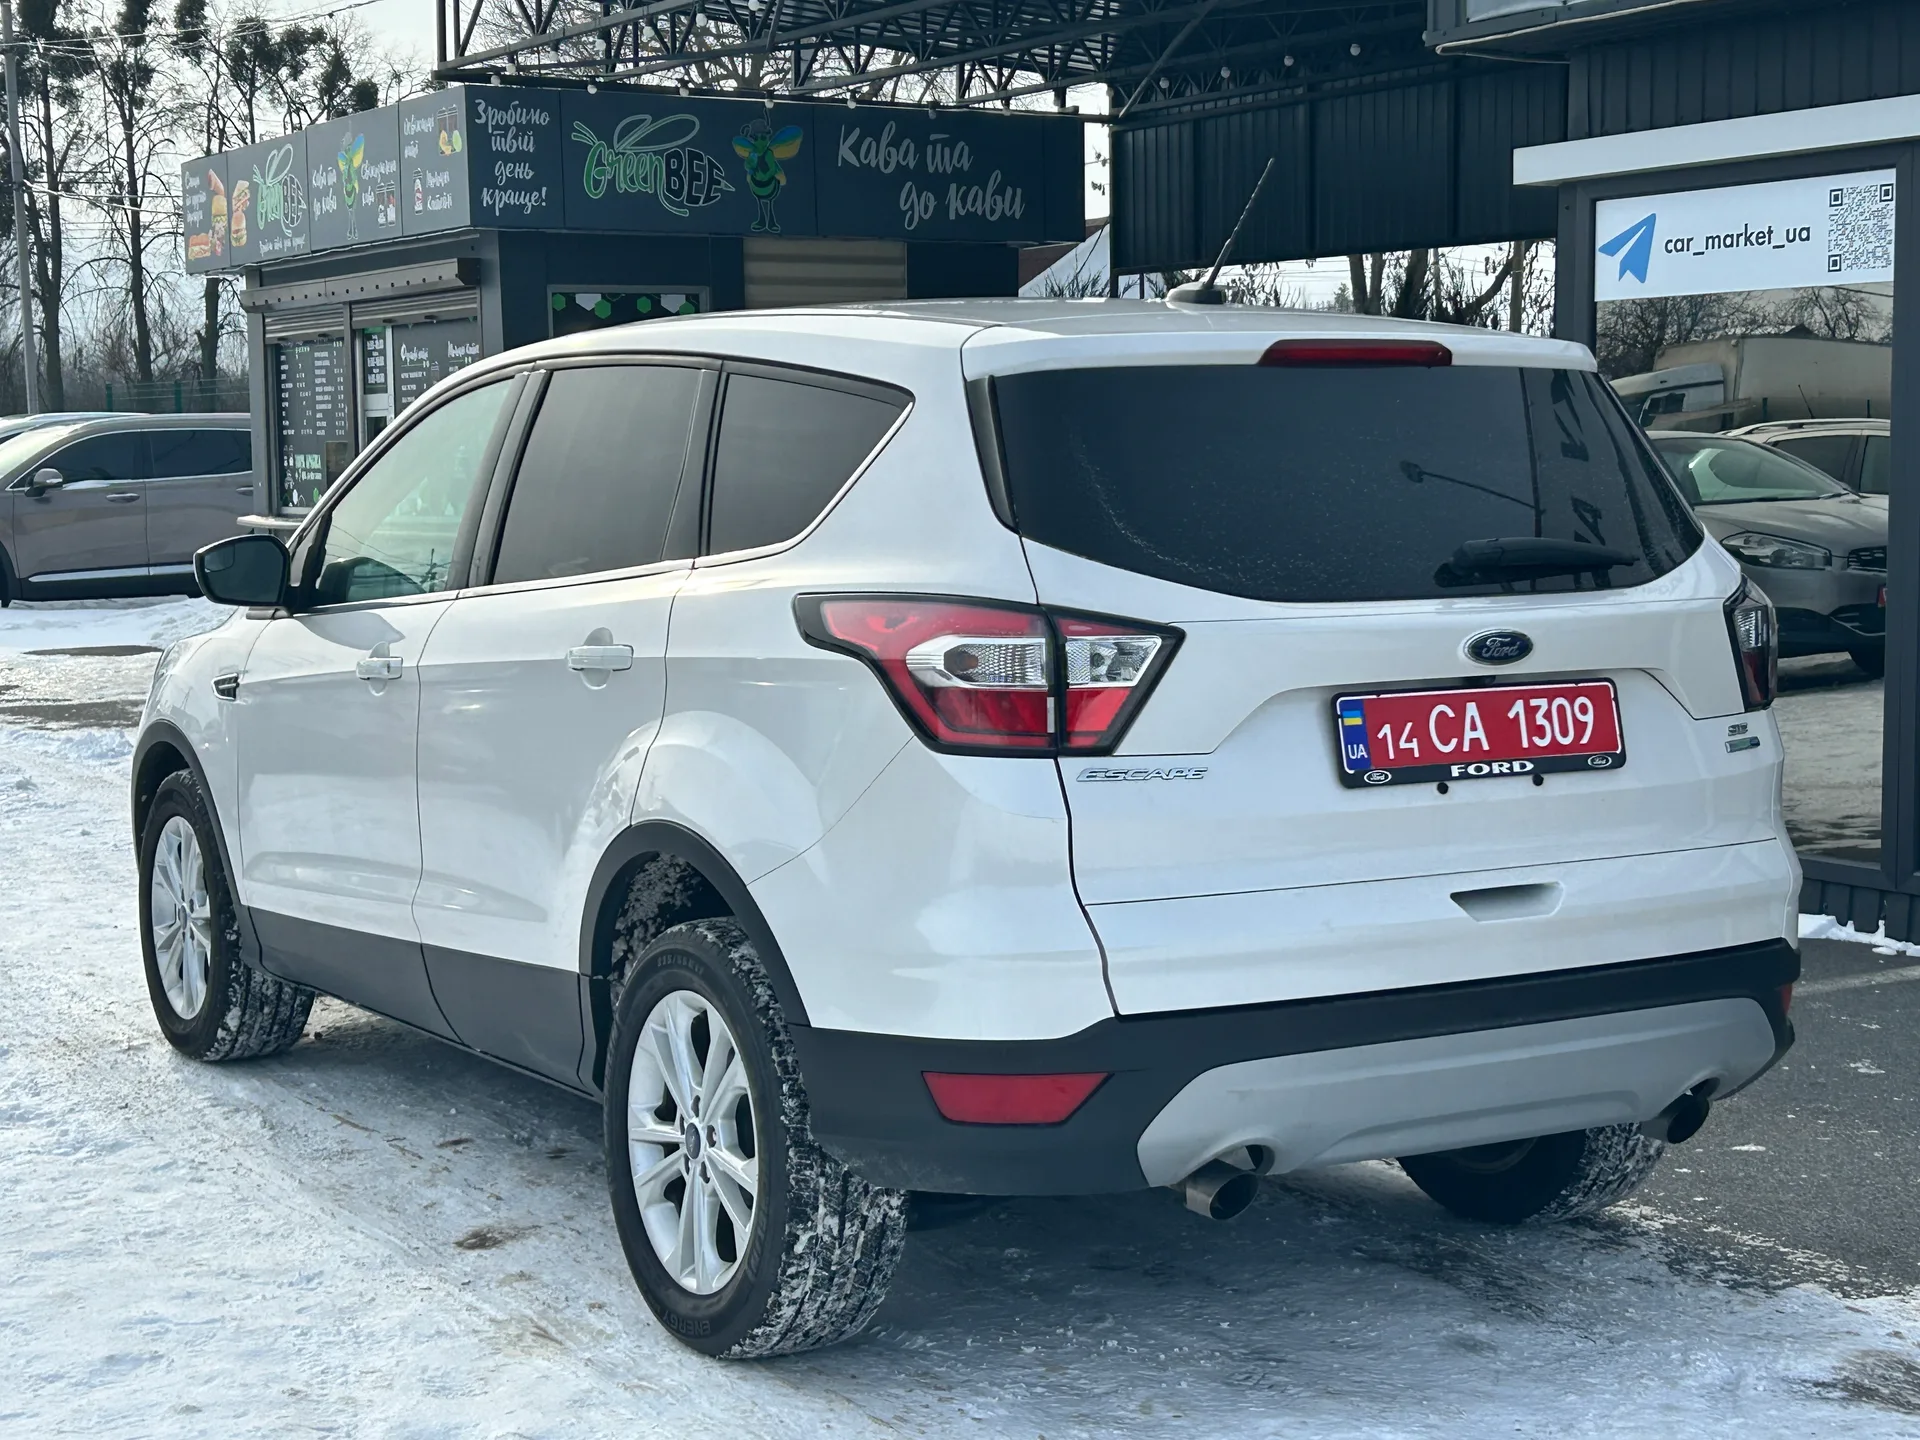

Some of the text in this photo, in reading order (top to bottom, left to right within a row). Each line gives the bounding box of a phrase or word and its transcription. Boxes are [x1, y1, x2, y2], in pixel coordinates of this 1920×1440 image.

[475, 99, 550, 132] Зробимо
[491, 127, 535, 152] твій
[837, 121, 974, 174] Кава та
[494, 161, 534, 185] день
[481, 187, 547, 216] краще!
[900, 170, 1025, 230] до кави
[1664, 223, 1811, 256] car_market_ua
[1482, 637, 1520, 657] Ford
[1377, 696, 1595, 759] 14 CA 1309
[1348, 744, 1368, 759] UA
[1076, 767, 1208, 782] ESCAPE
[1450, 760, 1534, 778] FORD
